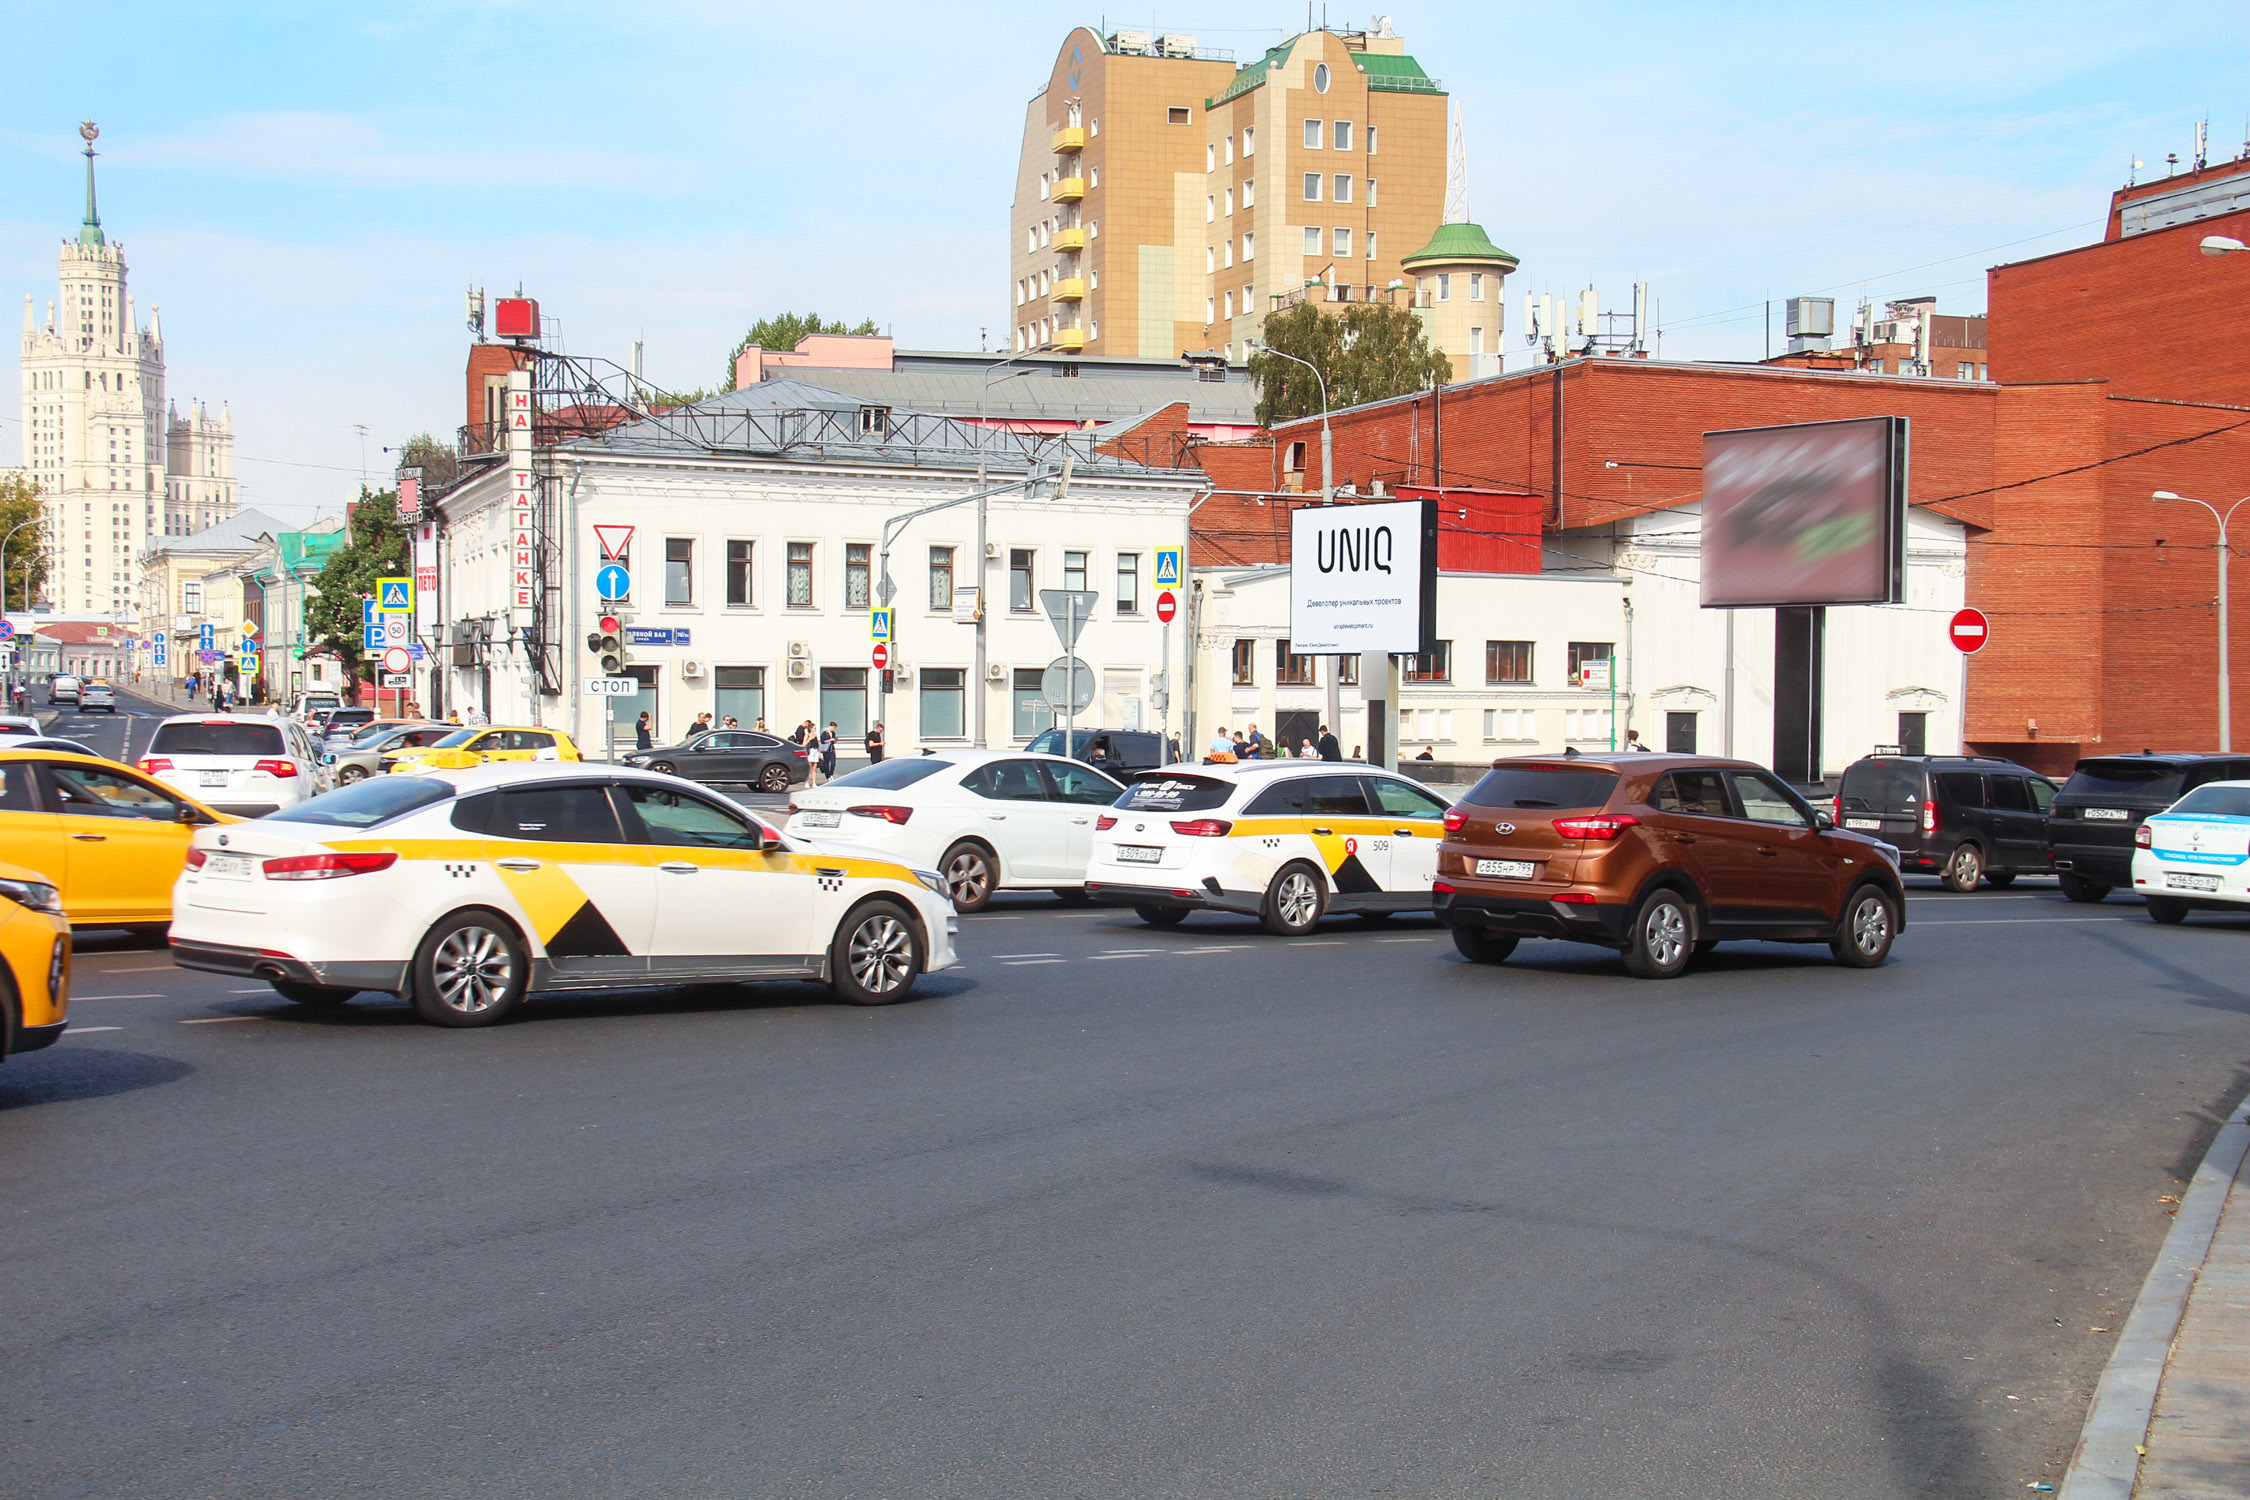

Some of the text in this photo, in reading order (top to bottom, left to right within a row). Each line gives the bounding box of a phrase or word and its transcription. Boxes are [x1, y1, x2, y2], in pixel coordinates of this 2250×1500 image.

[515, 394, 529, 605] НА ТАГАНКЕ
[1318, 526, 1392, 575] UNIQ
[418, 575, 437, 591] ЛЕТО
[1306, 598, 1402, 608] Девелопер уникальных проектов
[391, 626, 402, 634] 50
[590, 680, 630, 693] СТОП
[1347, 841, 1354, 852] Я
[1373, 840, 1389, 851] 509
[1516, 862, 1531, 873] 799
